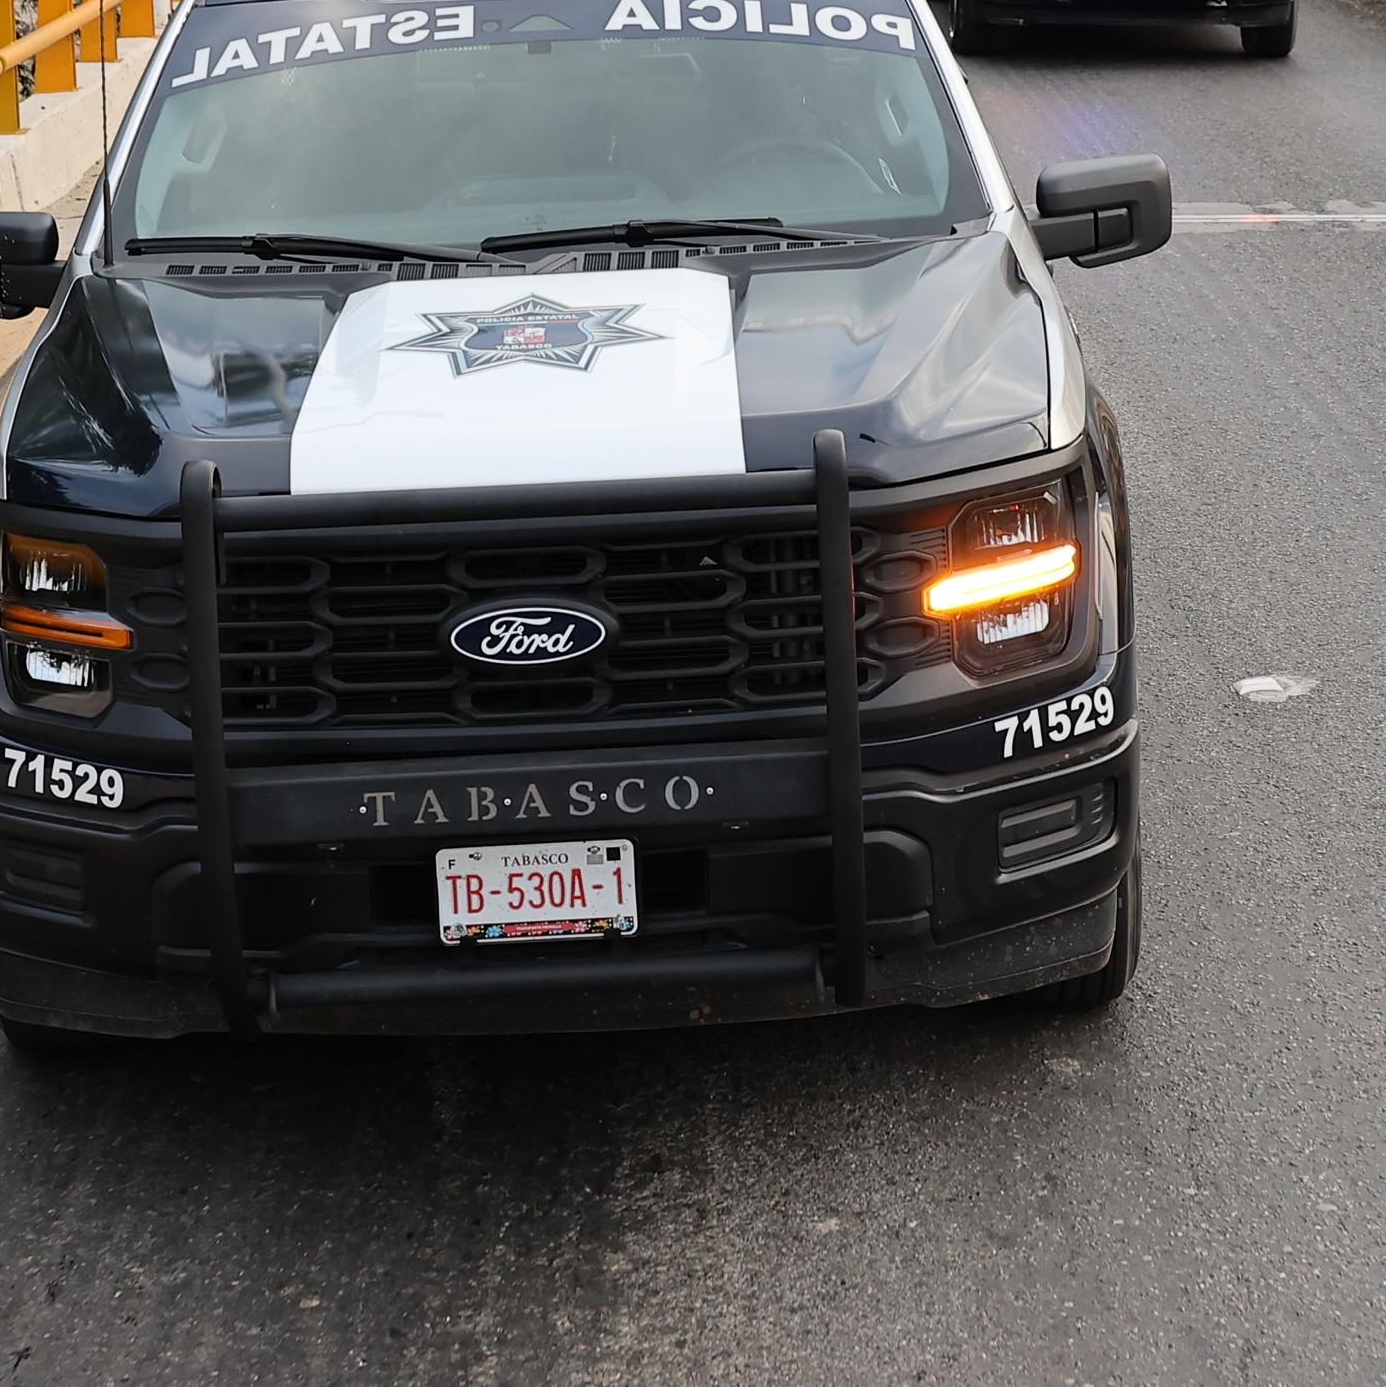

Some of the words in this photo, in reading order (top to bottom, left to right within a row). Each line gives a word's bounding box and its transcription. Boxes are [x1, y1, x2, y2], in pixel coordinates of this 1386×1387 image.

[480, 616, 576, 656] Ford
[994, 686, 1114, 758] 71529
[4, 747, 124, 809] 71529
[363, 775, 700, 827] TABASCO
[448, 859, 456, 870] F
[501, 853, 569, 868] TABASCO
[445, 867, 624, 915] TB-530A-1
